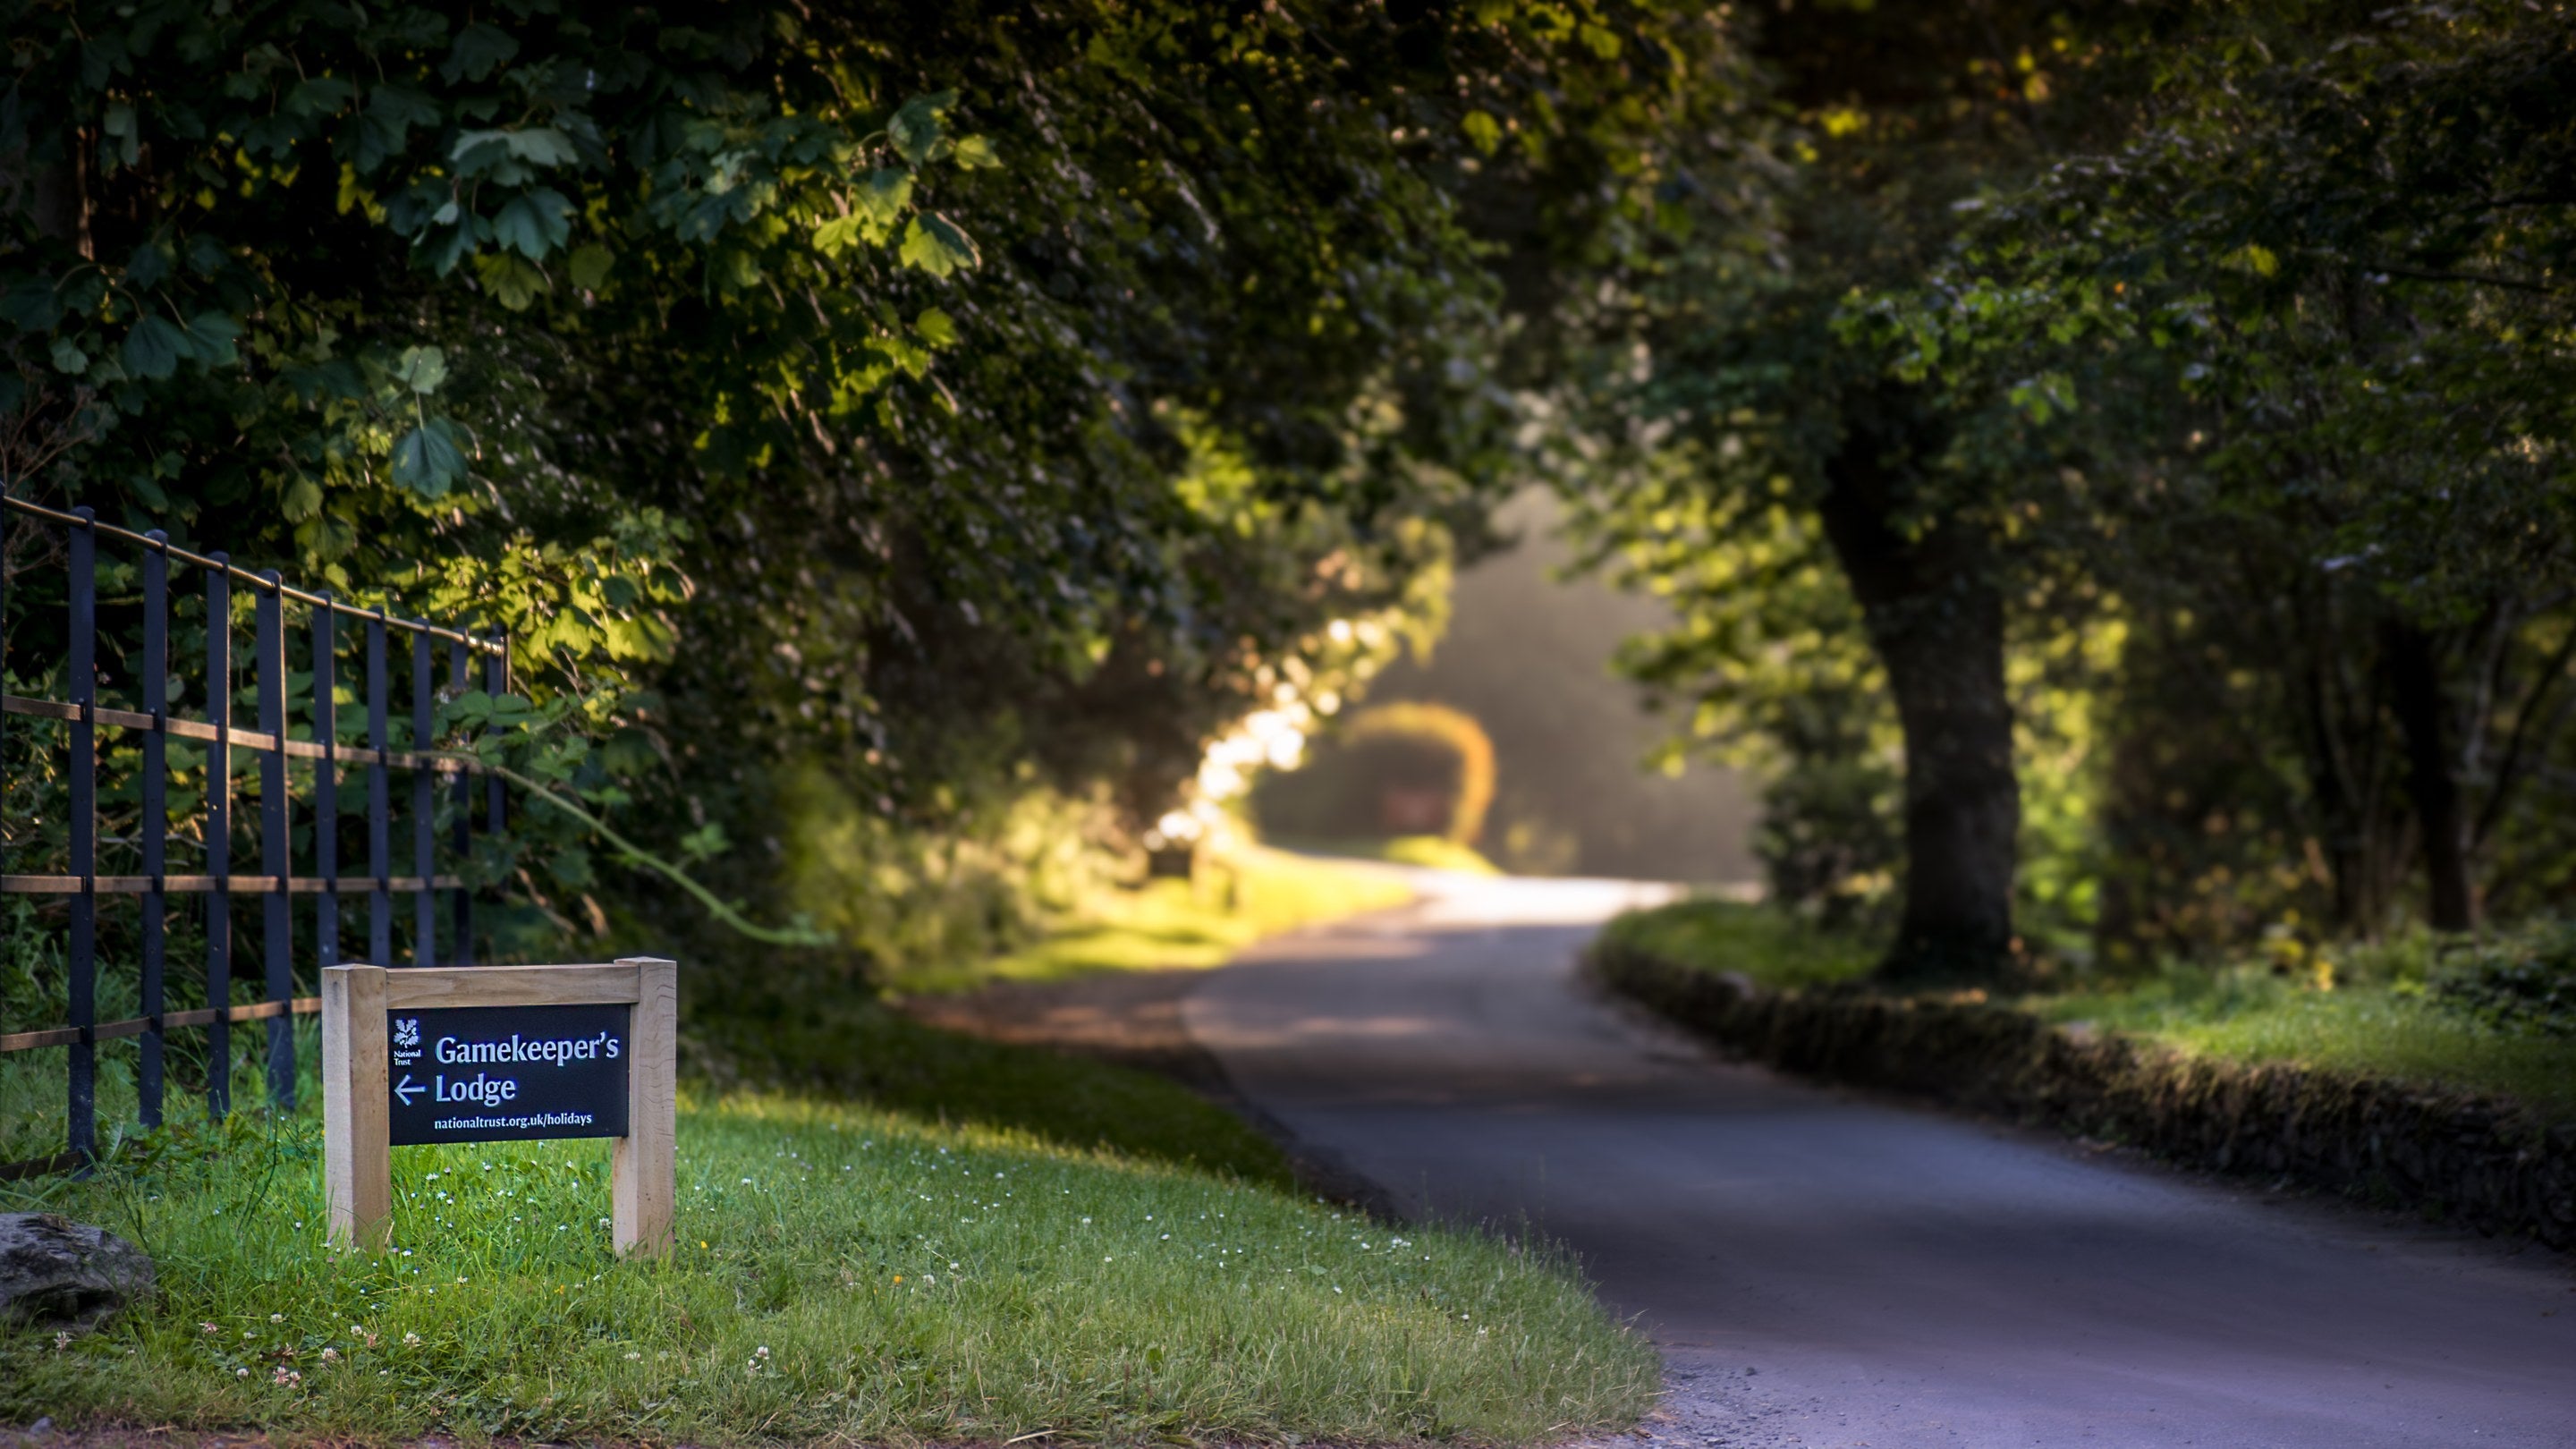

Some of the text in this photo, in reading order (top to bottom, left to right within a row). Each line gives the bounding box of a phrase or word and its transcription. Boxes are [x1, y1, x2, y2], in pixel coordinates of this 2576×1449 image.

[394, 1049, 421, 1058] National
[436, 1032, 619, 1066] Gamekeeper's
[436, 1072, 516, 1106] Lodge
[434, 1112, 592, 1130] nationaltrust.org.uk/holidays
